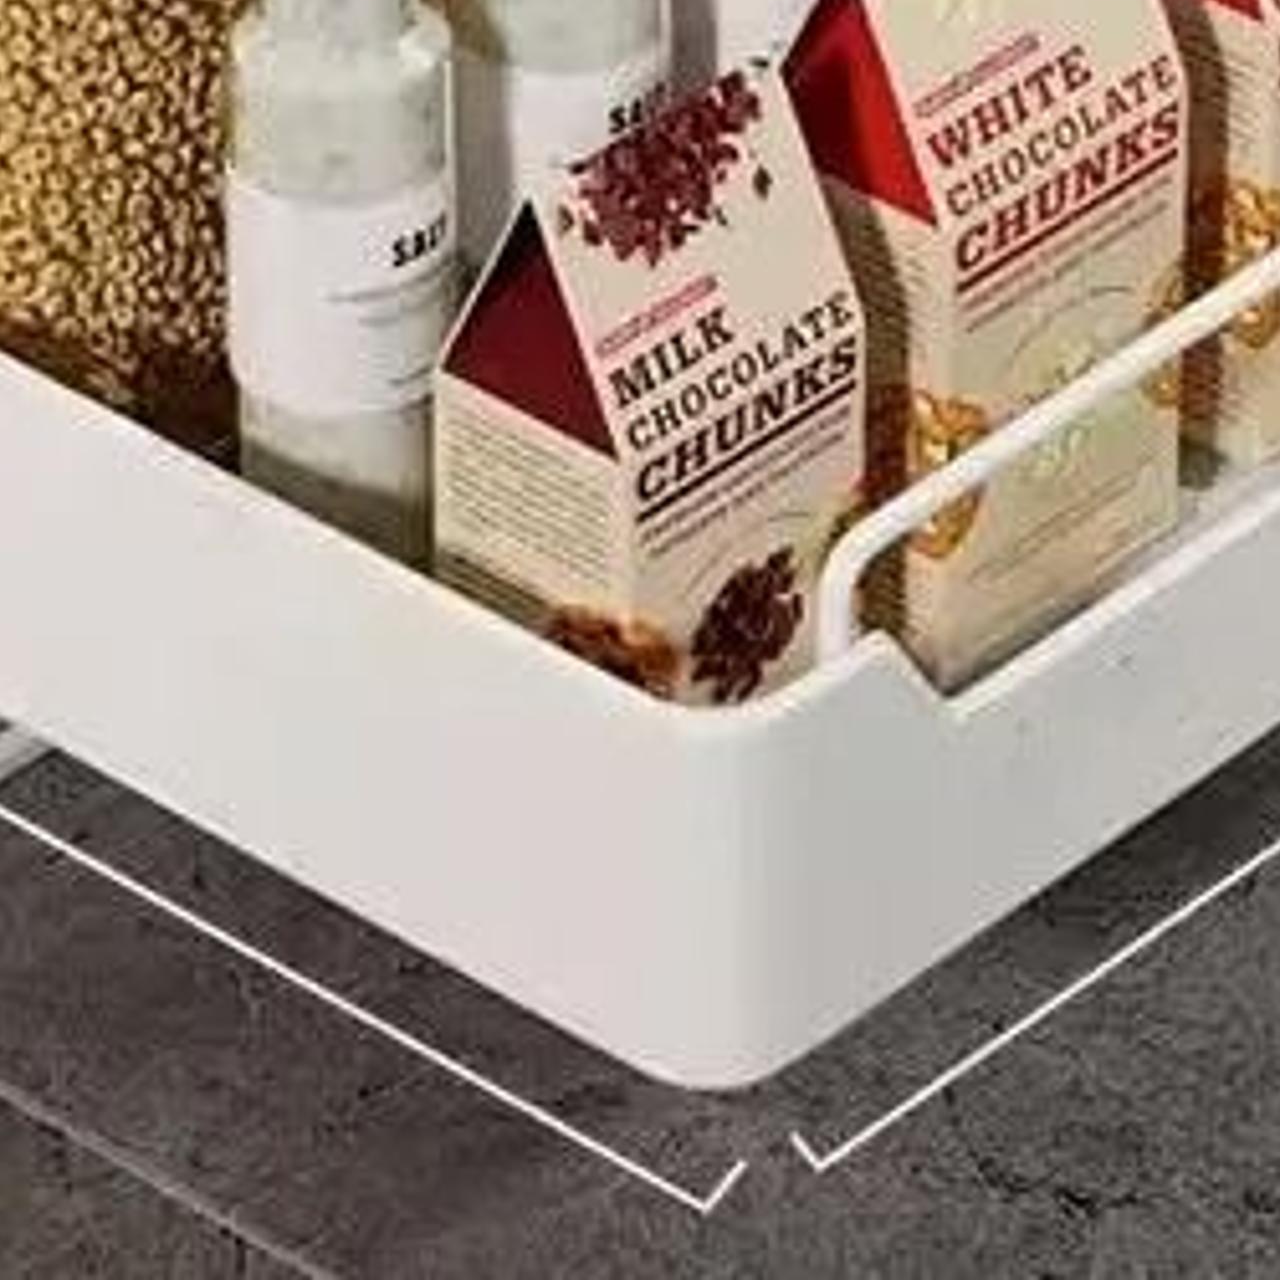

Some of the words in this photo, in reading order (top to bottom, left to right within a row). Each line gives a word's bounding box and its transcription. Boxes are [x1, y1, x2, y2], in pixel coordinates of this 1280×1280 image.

[927, 44, 1094, 170] WHITE
[946, 55, 1179, 217] CHOCOLATE
[955, 103, 1180, 271] CHUNKS
[608, 306, 735, 408] MILK
[627, 290, 856, 451] CHOCOLATE
[637, 337, 858, 502] CHUNKS
